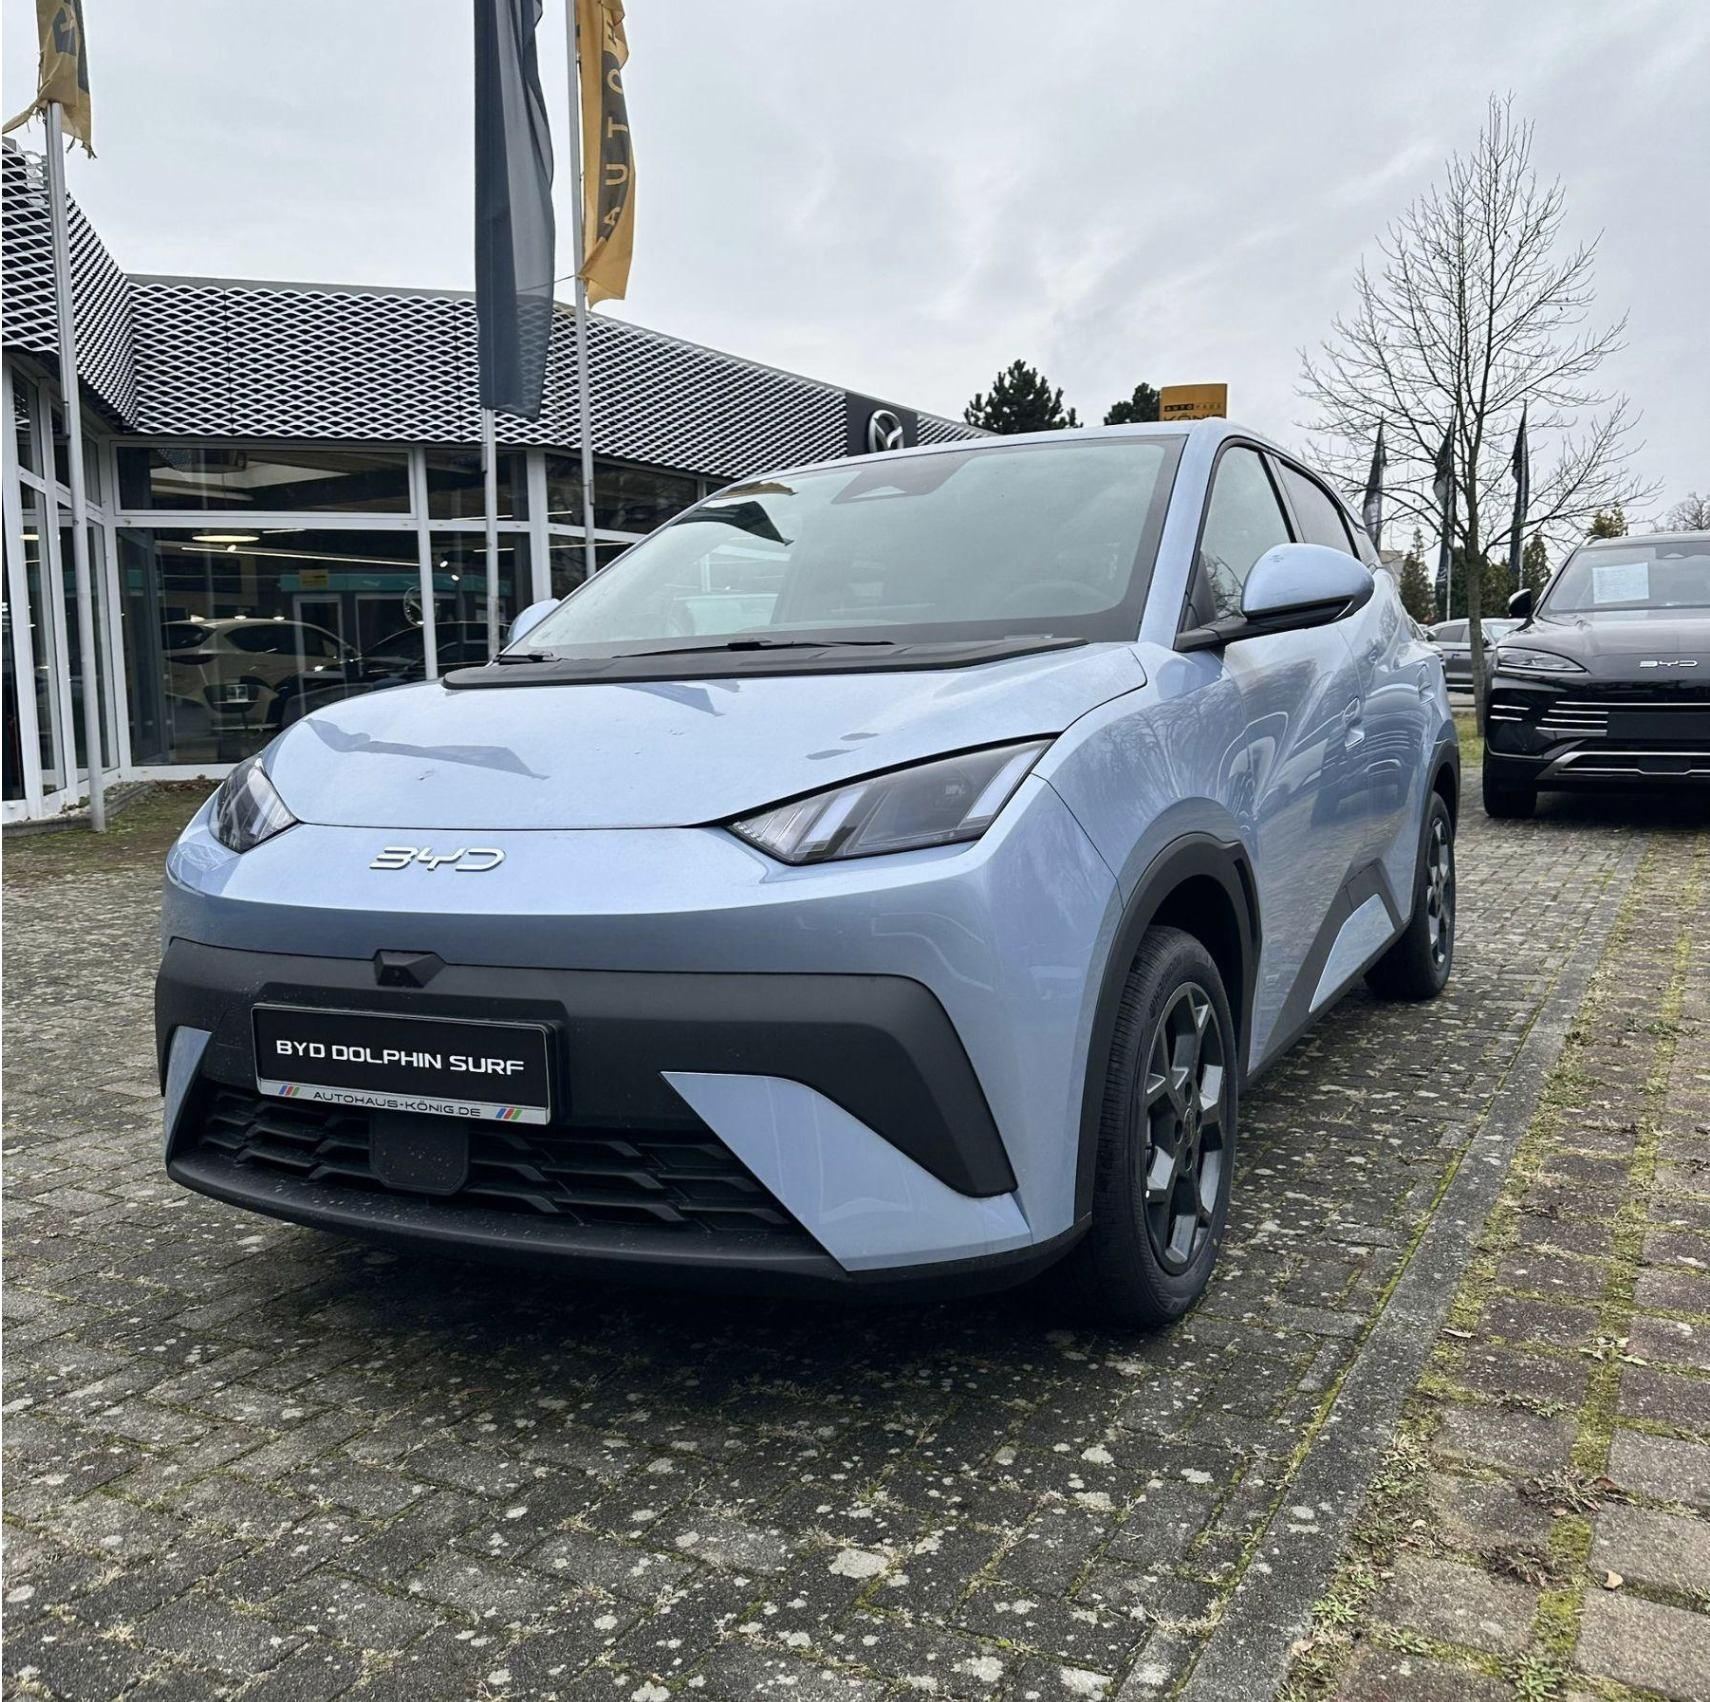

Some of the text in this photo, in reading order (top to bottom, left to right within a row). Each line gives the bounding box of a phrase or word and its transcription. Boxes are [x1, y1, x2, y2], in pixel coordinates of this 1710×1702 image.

[1639, 660, 1698, 668] BYD
[369, 846, 505, 872] BYD
[276, 1040, 525, 1075] BYD DOLPHIN SURF
[313, 1091, 482, 1116] AUTOHAUS-KÖNIG.DE
